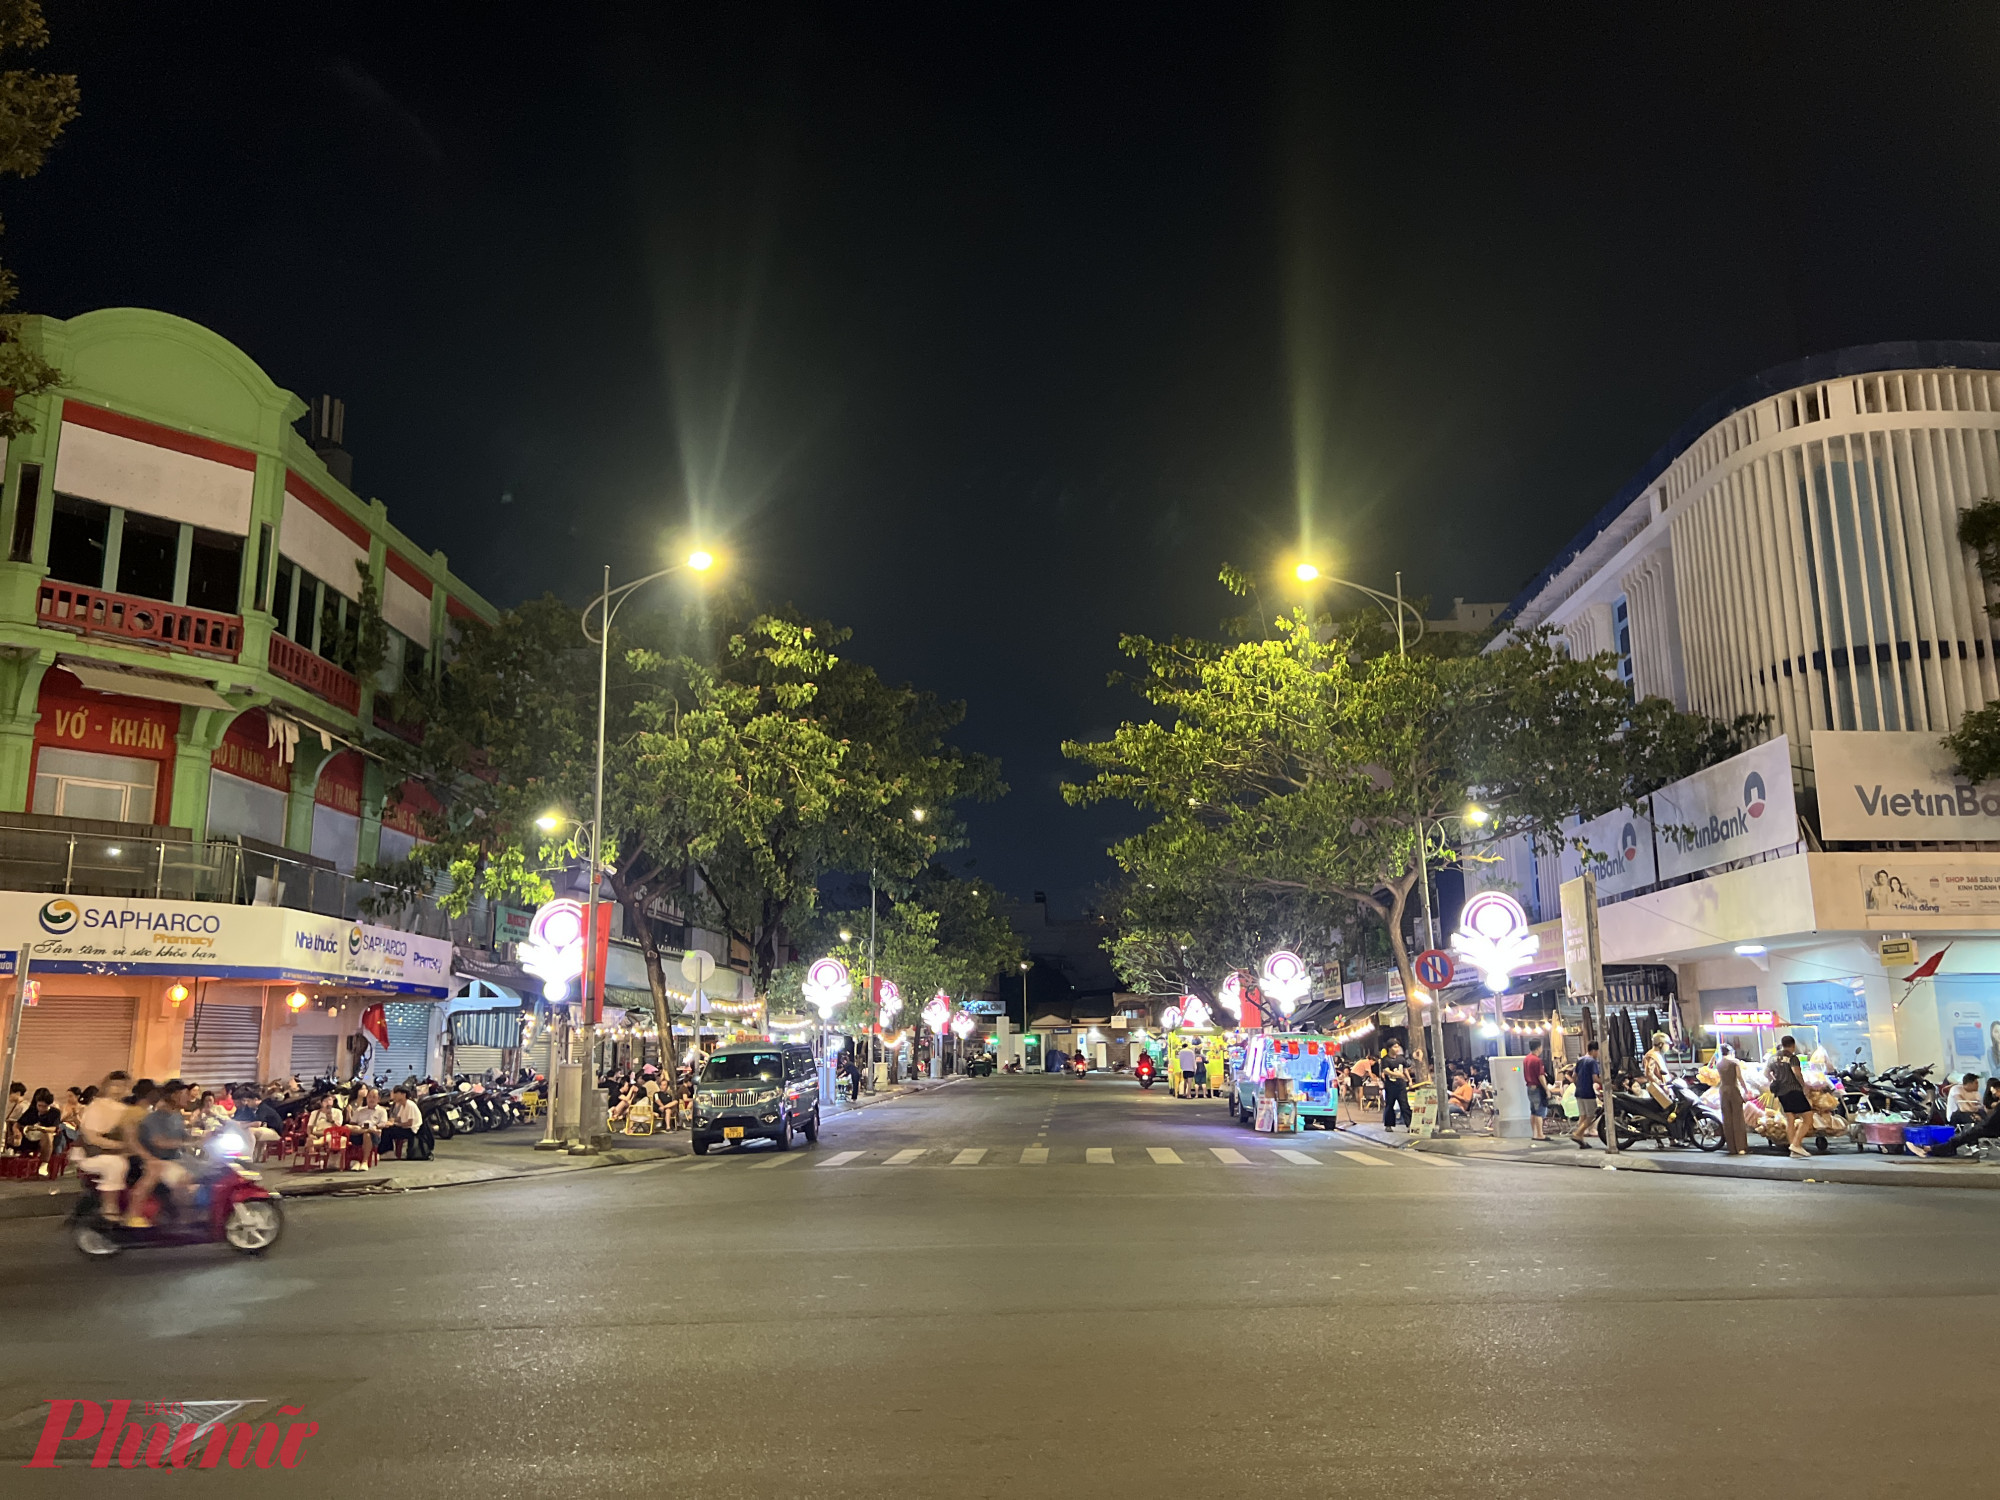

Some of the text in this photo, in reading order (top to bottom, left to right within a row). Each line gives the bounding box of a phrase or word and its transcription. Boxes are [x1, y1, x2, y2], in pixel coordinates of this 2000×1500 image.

[55, 706, 89, 740] VỚ
[110, 717, 166, 750] KHĂN
[1945, 876, 1964, 884] SHOP
[83, 909, 221, 934] SAPHARCO
[153, 933, 215, 948] Pharmacy
[295, 931, 338, 954] Nhà thuốc
[362, 935, 408, 957] SAPHARCO
